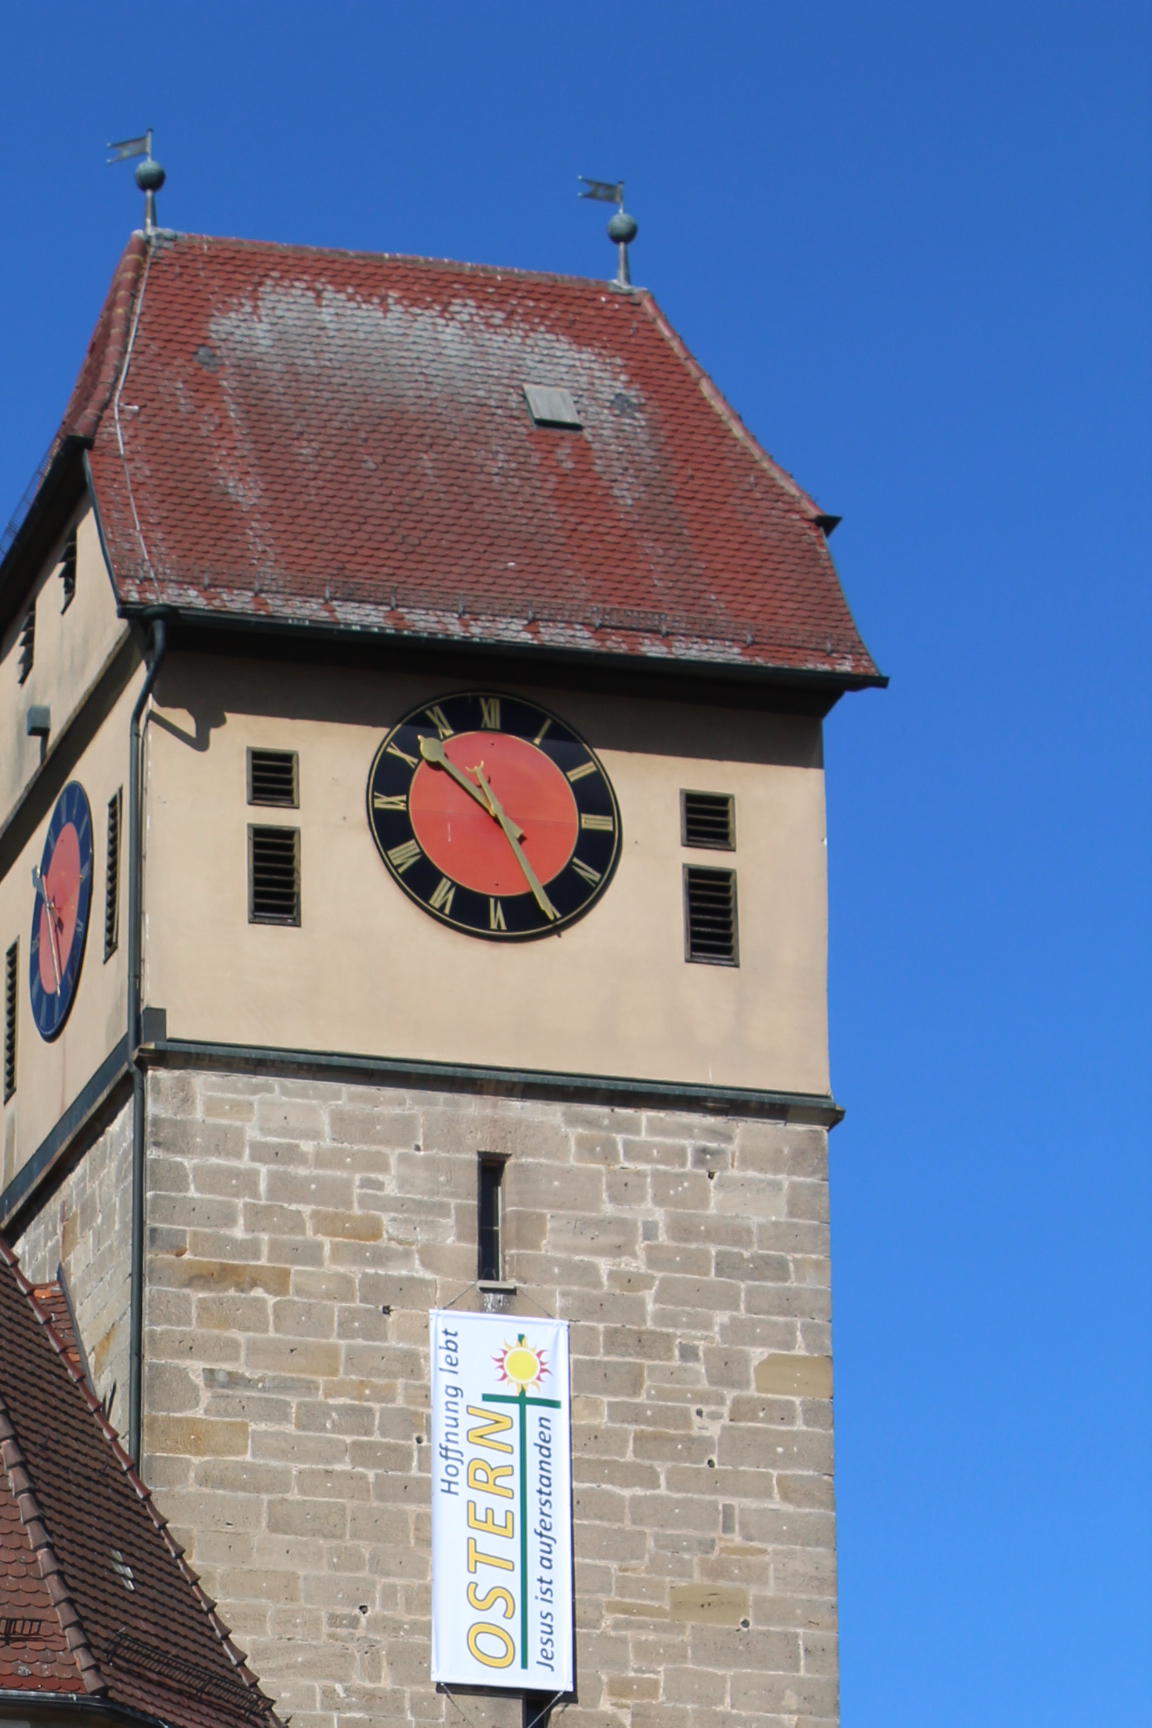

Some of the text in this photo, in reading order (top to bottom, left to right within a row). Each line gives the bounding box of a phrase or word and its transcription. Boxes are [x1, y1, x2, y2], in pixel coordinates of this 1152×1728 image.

[438, 1327, 464, 1496] Hoffnung lebt
[466, 1404, 516, 1669] OSTERN
[533, 1416, 557, 1672] Jesus ist auferstanden
